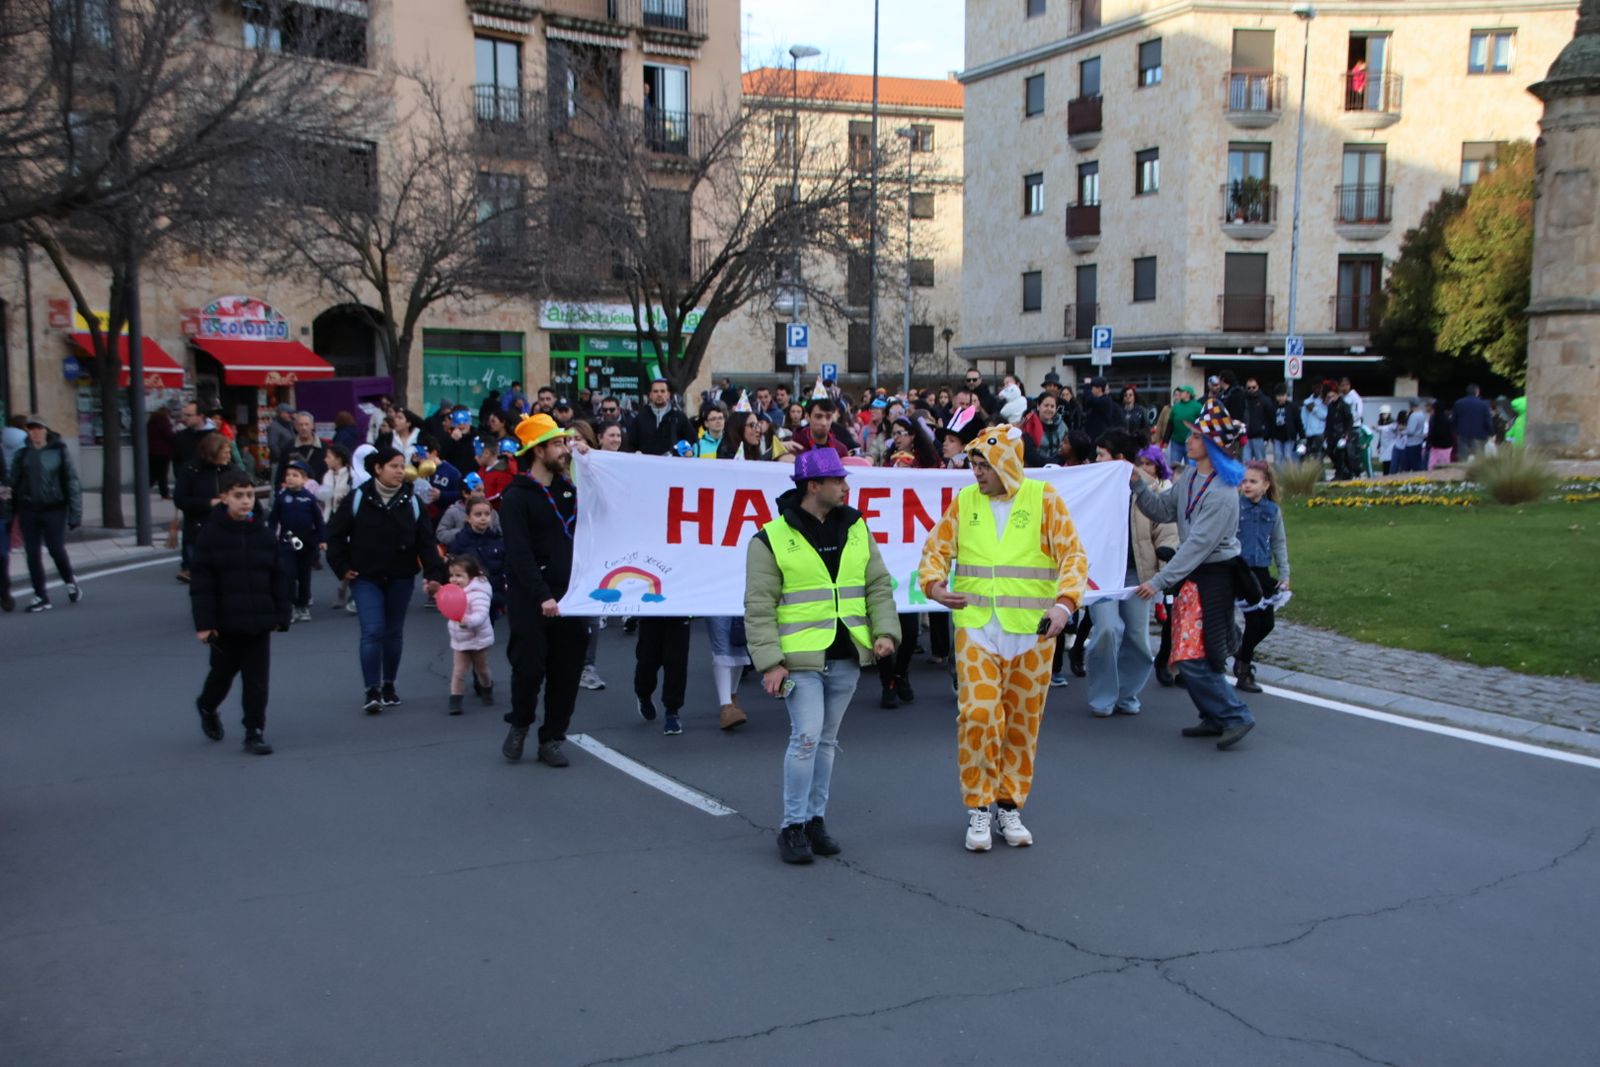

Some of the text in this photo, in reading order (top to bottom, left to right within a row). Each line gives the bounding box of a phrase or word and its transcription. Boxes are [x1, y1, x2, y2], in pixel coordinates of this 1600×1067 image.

[791, 325, 805, 346] P
[1096, 329, 1109, 347] P
[482, 367, 495, 390] 4
[824, 364, 835, 379] P
